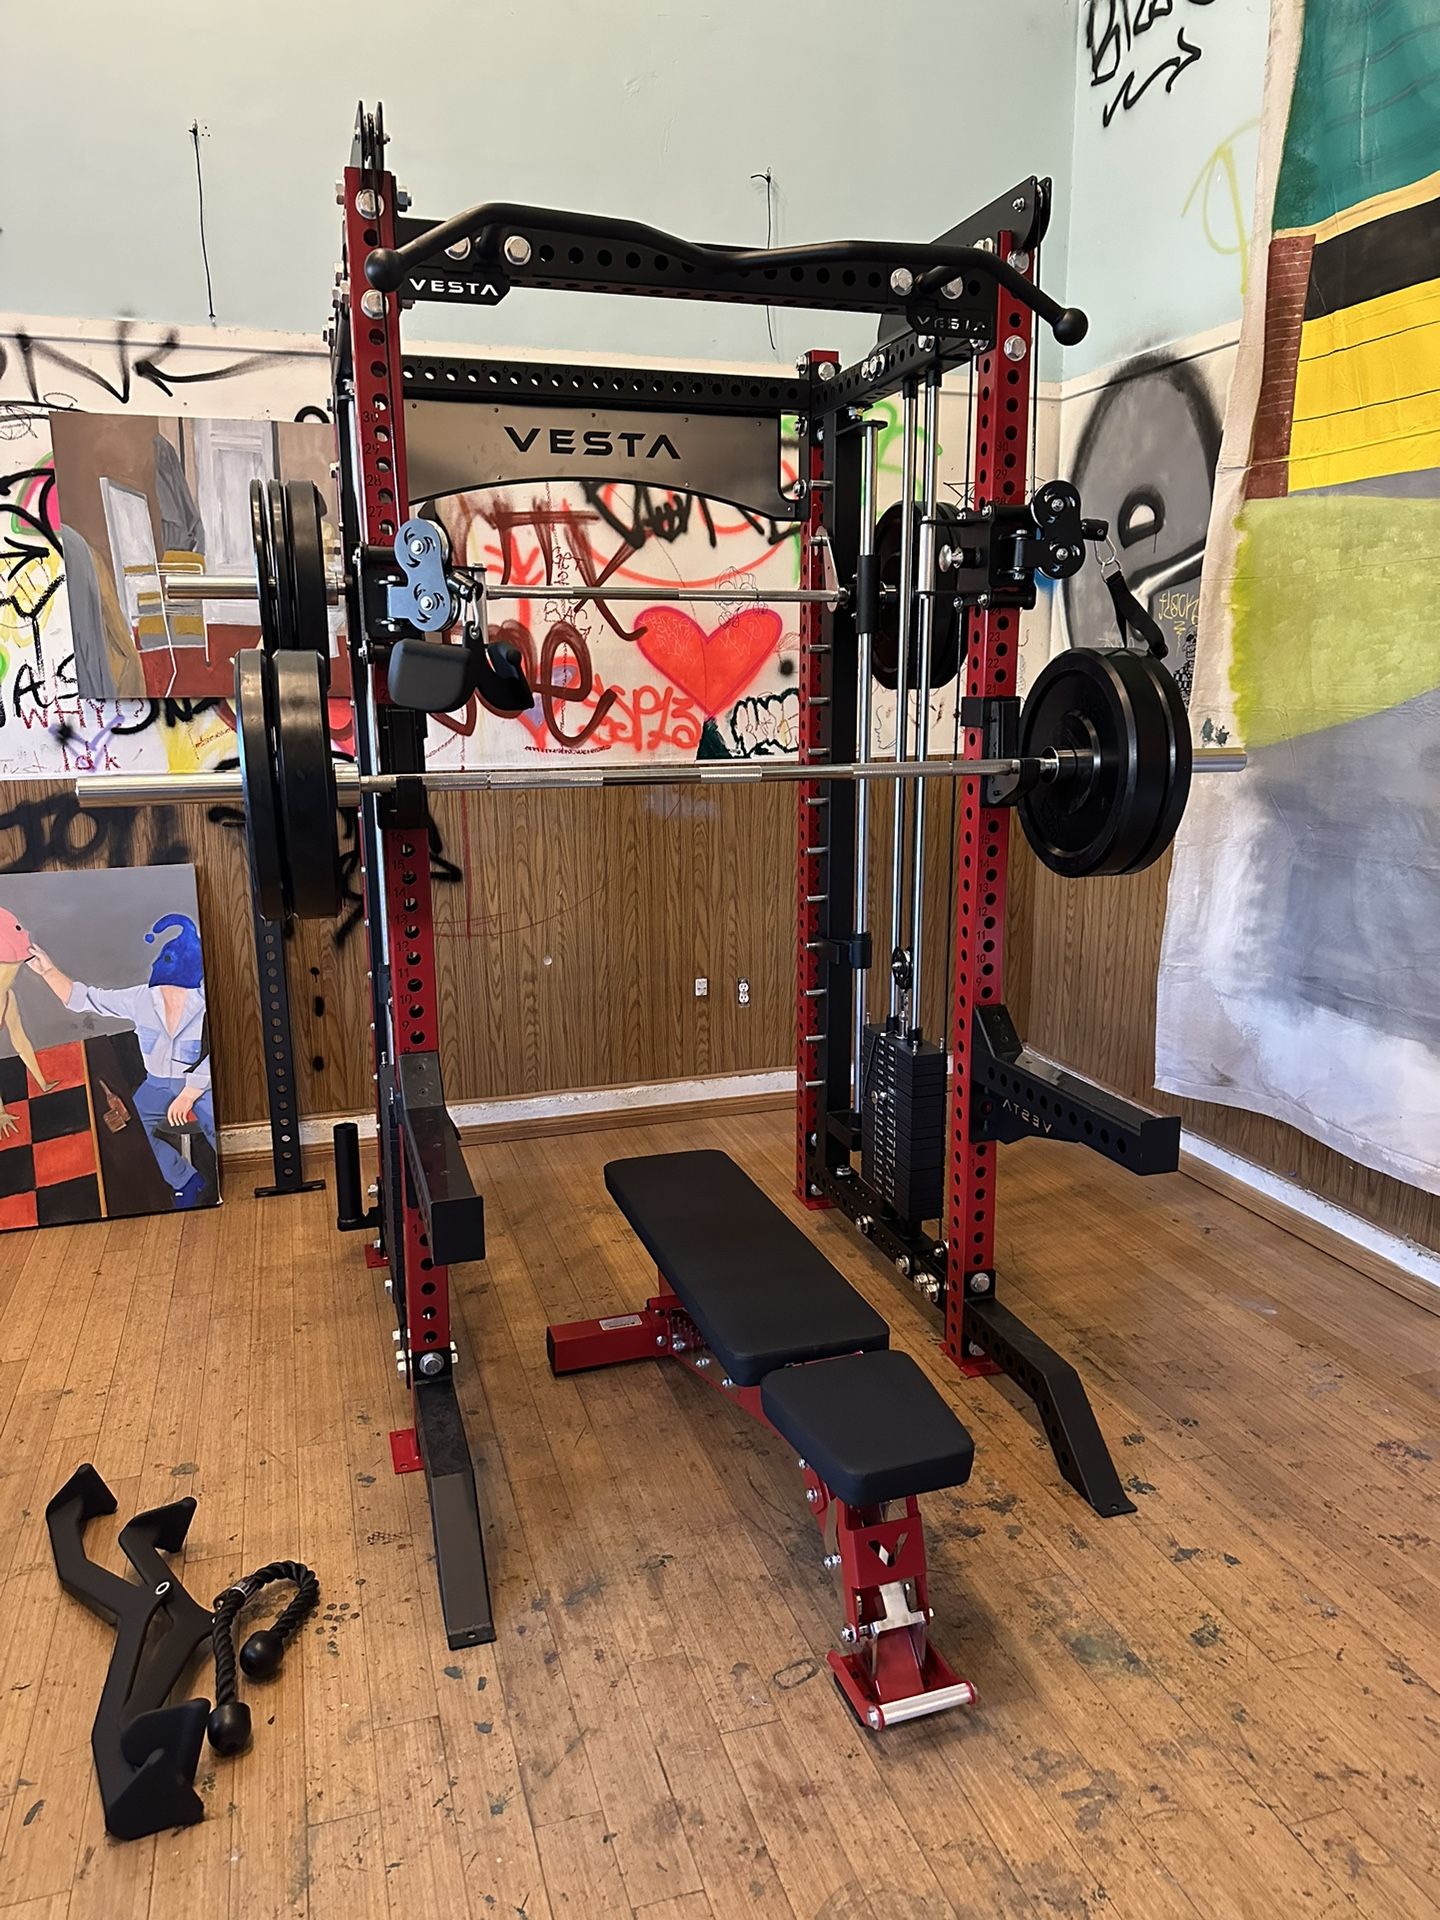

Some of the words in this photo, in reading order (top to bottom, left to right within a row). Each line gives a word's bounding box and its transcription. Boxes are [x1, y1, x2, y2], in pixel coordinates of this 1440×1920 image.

[409, 278, 499, 297] VESTA
[504, 426, 682, 459] VESTA
[365, 443, 380, 455] 29
[996, 469, 1008, 480] 29
[366, 475, 382, 487] 28
[368, 506, 383, 518] 27
[988, 632, 1000, 641] 23
[987, 658, 999, 668] 22
[986, 683, 996, 692] 21
[982, 810, 991, 819] 16
[390, 832, 402, 841] 16
[981, 835, 990, 844] 15
[392, 861, 404, 870] 15
[980, 859, 989, 868] 14
[979, 883, 988, 891] 13
[394, 888, 406, 897] 14
[978, 908, 987, 917] 12
[395, 915, 407, 925] 13
[977, 931, 986, 939] 11
[397, 941, 408, 951] 12
[976, 954, 985, 963] 10
[398, 968, 409, 978] 11
[976, 977, 982, 986] 9
[400, 995, 411, 1004] 10
[402, 1022, 409, 1031] 9
[413, 1224, 418, 1234] 1
